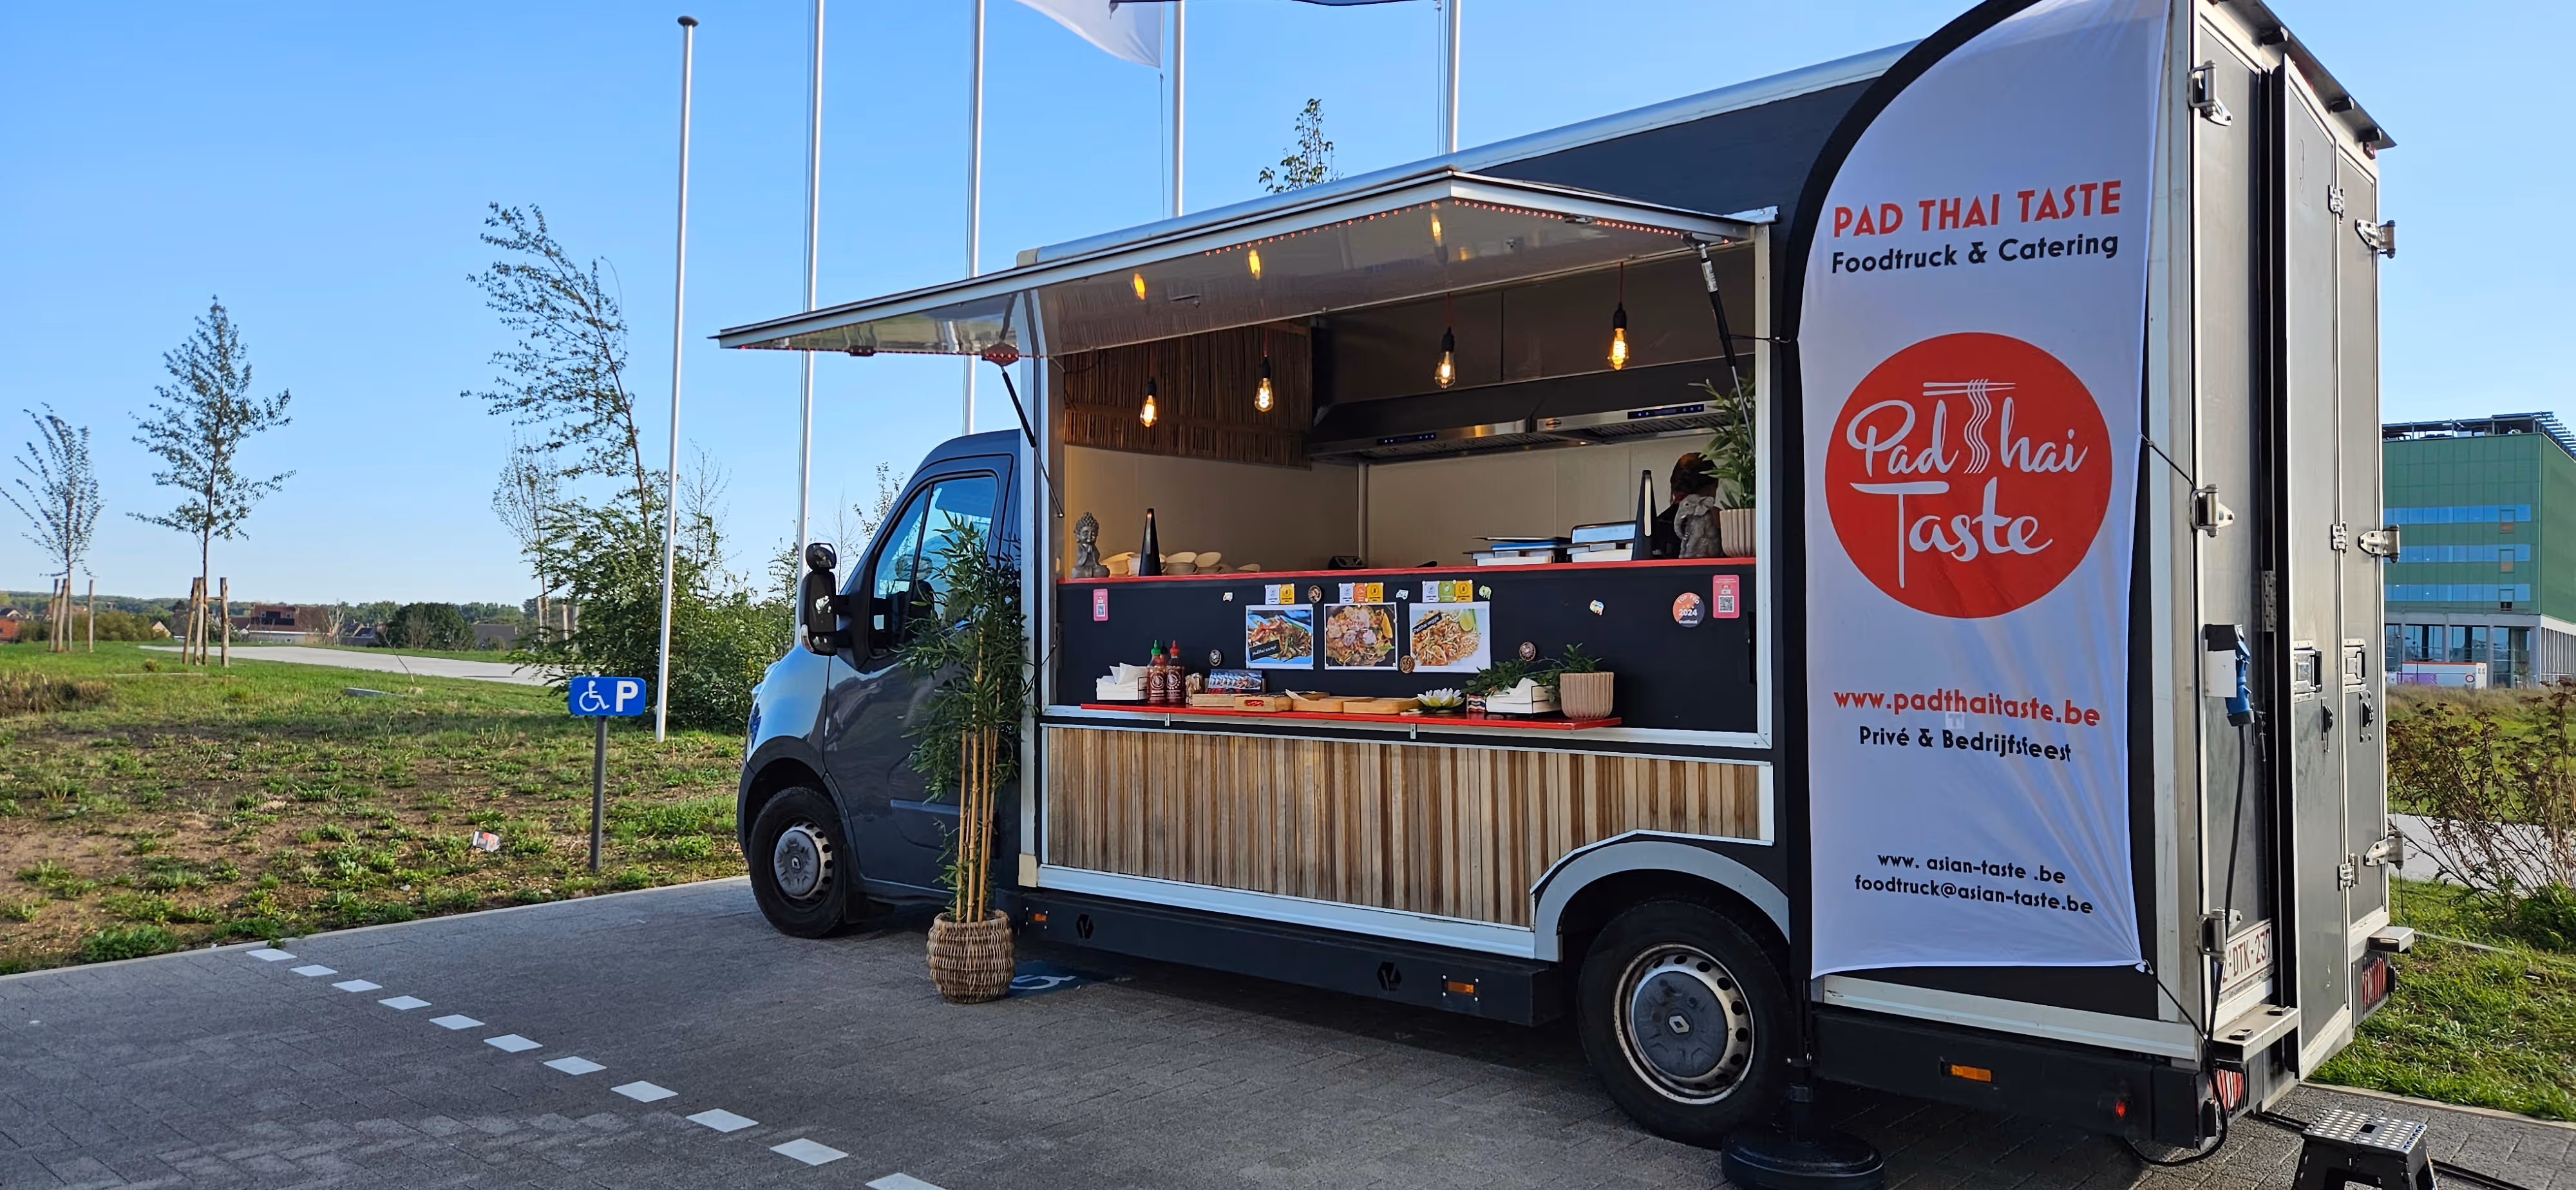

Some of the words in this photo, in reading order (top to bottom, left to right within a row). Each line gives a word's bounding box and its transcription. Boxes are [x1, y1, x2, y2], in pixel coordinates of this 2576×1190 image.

[1834, 203, 1903, 238] PAD
[1918, 194, 2000, 231] THAI
[2017, 180, 2121, 222] TASTE
[1832, 244, 1958, 274] Foodtruck
[1968, 241, 1988, 264] &
[1998, 233, 2119, 260] Catering
[1846, 399, 1958, 478] Pad
[1850, 477, 2053, 589] Taste
[616, 680, 638, 712] P
[1833, 688, 2101, 726] www.padthaitaste.be
[1859, 726, 1910, 747] Privé
[1918, 728, 1934, 748] &
[1942, 729, 2072, 762] Bedrijfsfeest
[1877, 854, 1920, 869] www.
[1926, 855, 2027, 880] asian-taste
[2033, 864, 2067, 884] .be
[1855, 874, 2094, 914] foodtruck@asian-taste.be
